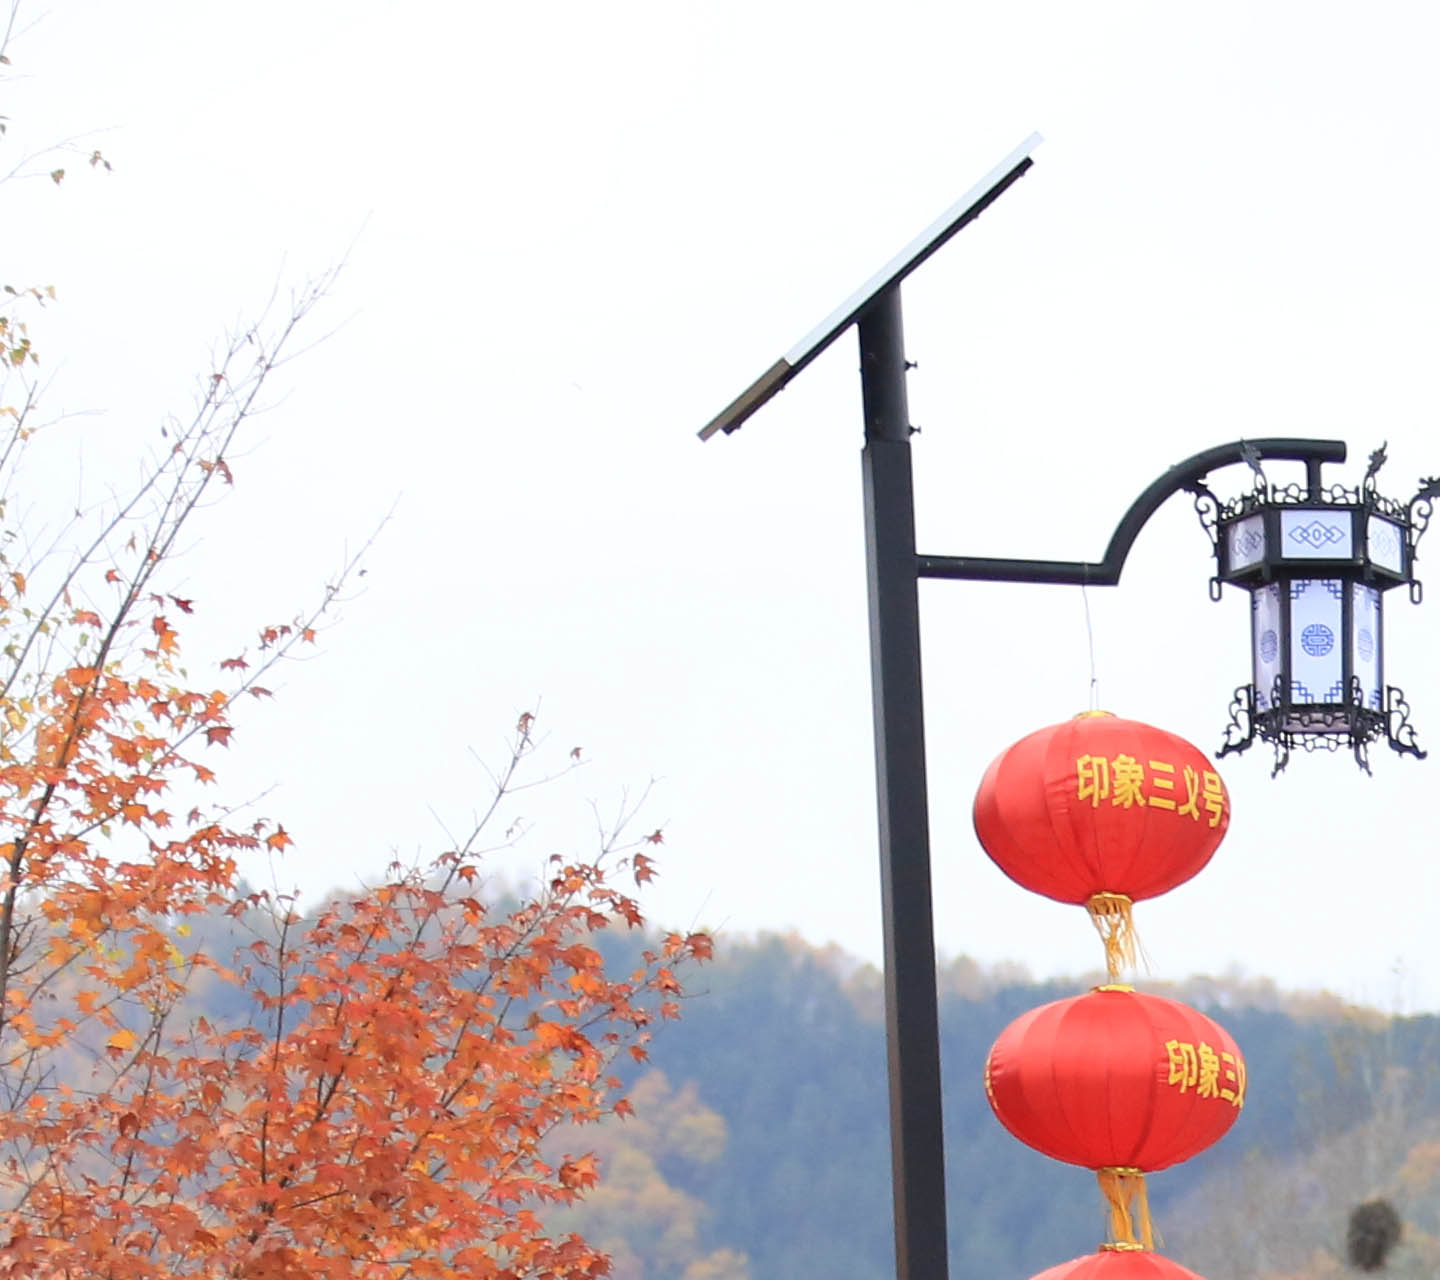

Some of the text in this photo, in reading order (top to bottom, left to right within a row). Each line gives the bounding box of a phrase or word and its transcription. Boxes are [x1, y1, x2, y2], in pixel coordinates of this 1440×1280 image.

[1076, 754, 1225, 828] 印象三义号
